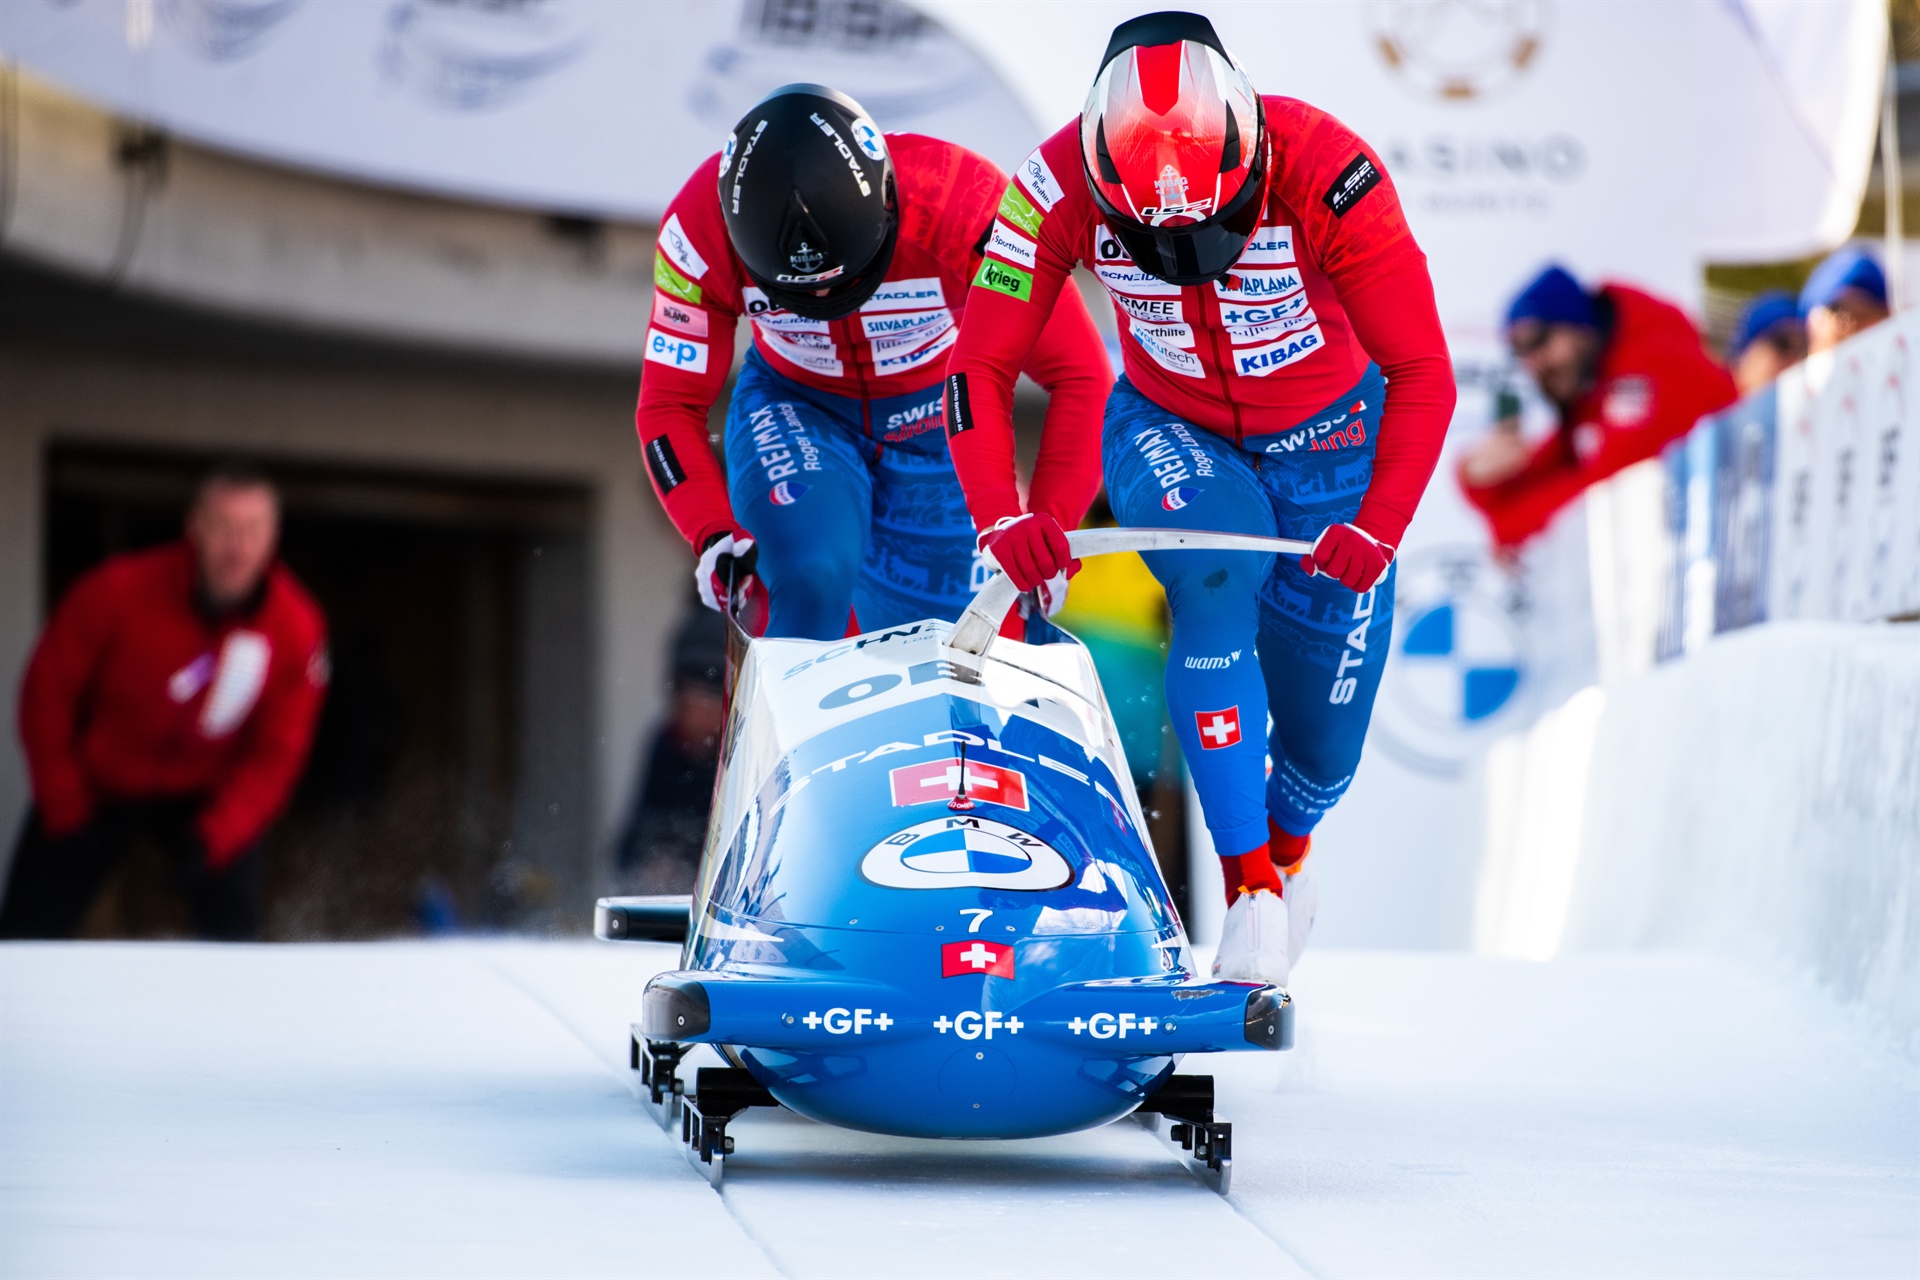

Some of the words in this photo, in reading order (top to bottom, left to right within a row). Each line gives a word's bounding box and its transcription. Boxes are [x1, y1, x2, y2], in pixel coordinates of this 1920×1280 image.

[732, 119, 768, 215] STADLER
[810, 112, 871, 197] STADLER
[1388, 134, 1588, 184] ASINO
[1153, 177, 1189, 189] KIBAG
[1332, 160, 1372, 205] LS2
[1247, 241, 1289, 251] DLER
[985, 260, 1021, 293] krieg
[652, 335, 698, 366] e+p
[1240, 334, 1318, 374] KIBAG
[795, 435, 822, 471] Roger
[1188, 448, 1215, 478] Roger
[1184, 653, 1233, 670] wams
[768, 729, 1134, 829] STADLER
[884, 817, 1044, 847] BMW
[959, 908, 994, 934] 7
[802, 1007, 894, 1035] +GF+
[933, 1010, 1025, 1040] +GF+
[1068, 1012, 1158, 1039] +GF+
